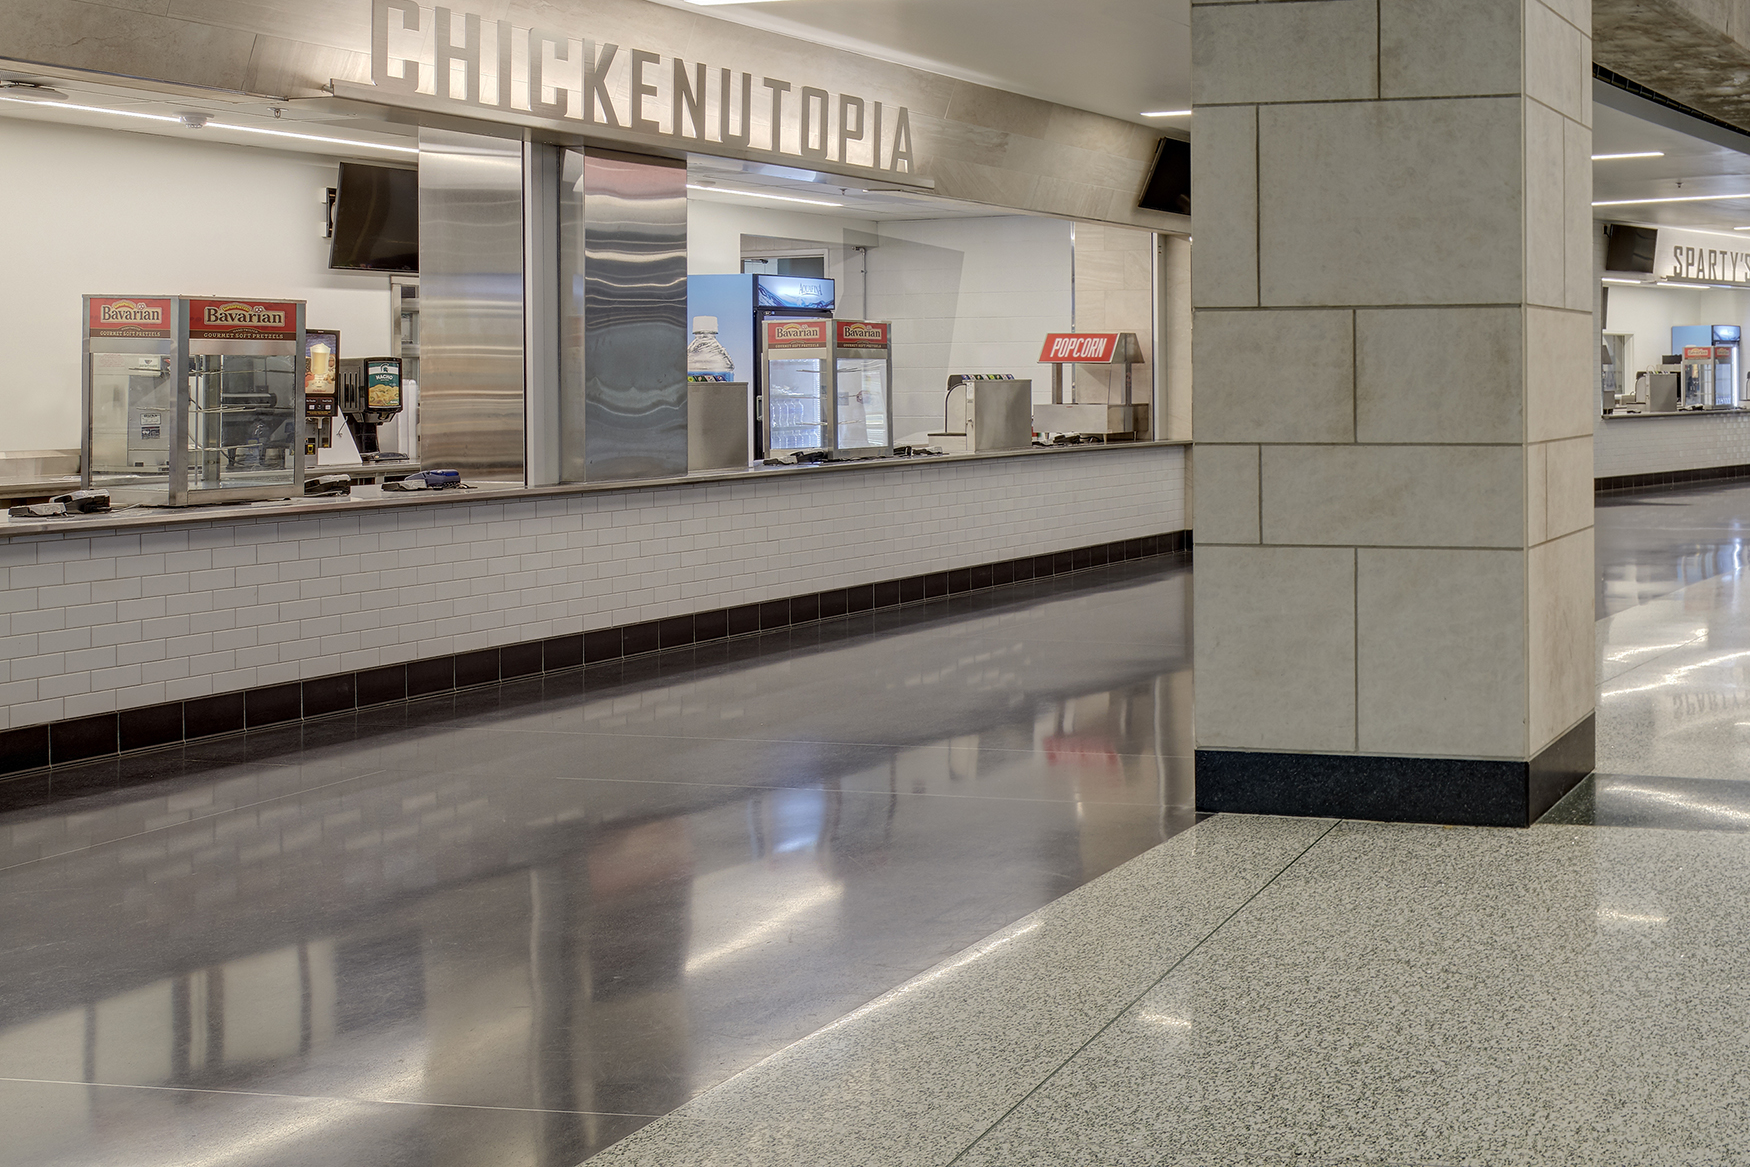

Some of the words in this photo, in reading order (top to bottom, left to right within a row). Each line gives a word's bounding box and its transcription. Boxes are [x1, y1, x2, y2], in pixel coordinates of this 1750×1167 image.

[102, 306, 160, 320] Bavarian
[206, 307, 282, 323] Bavarian
[776, 327, 818, 338] Bavarian
[844, 327, 881, 338] Bavarian
[1050, 338, 1107, 358] POPCORN
